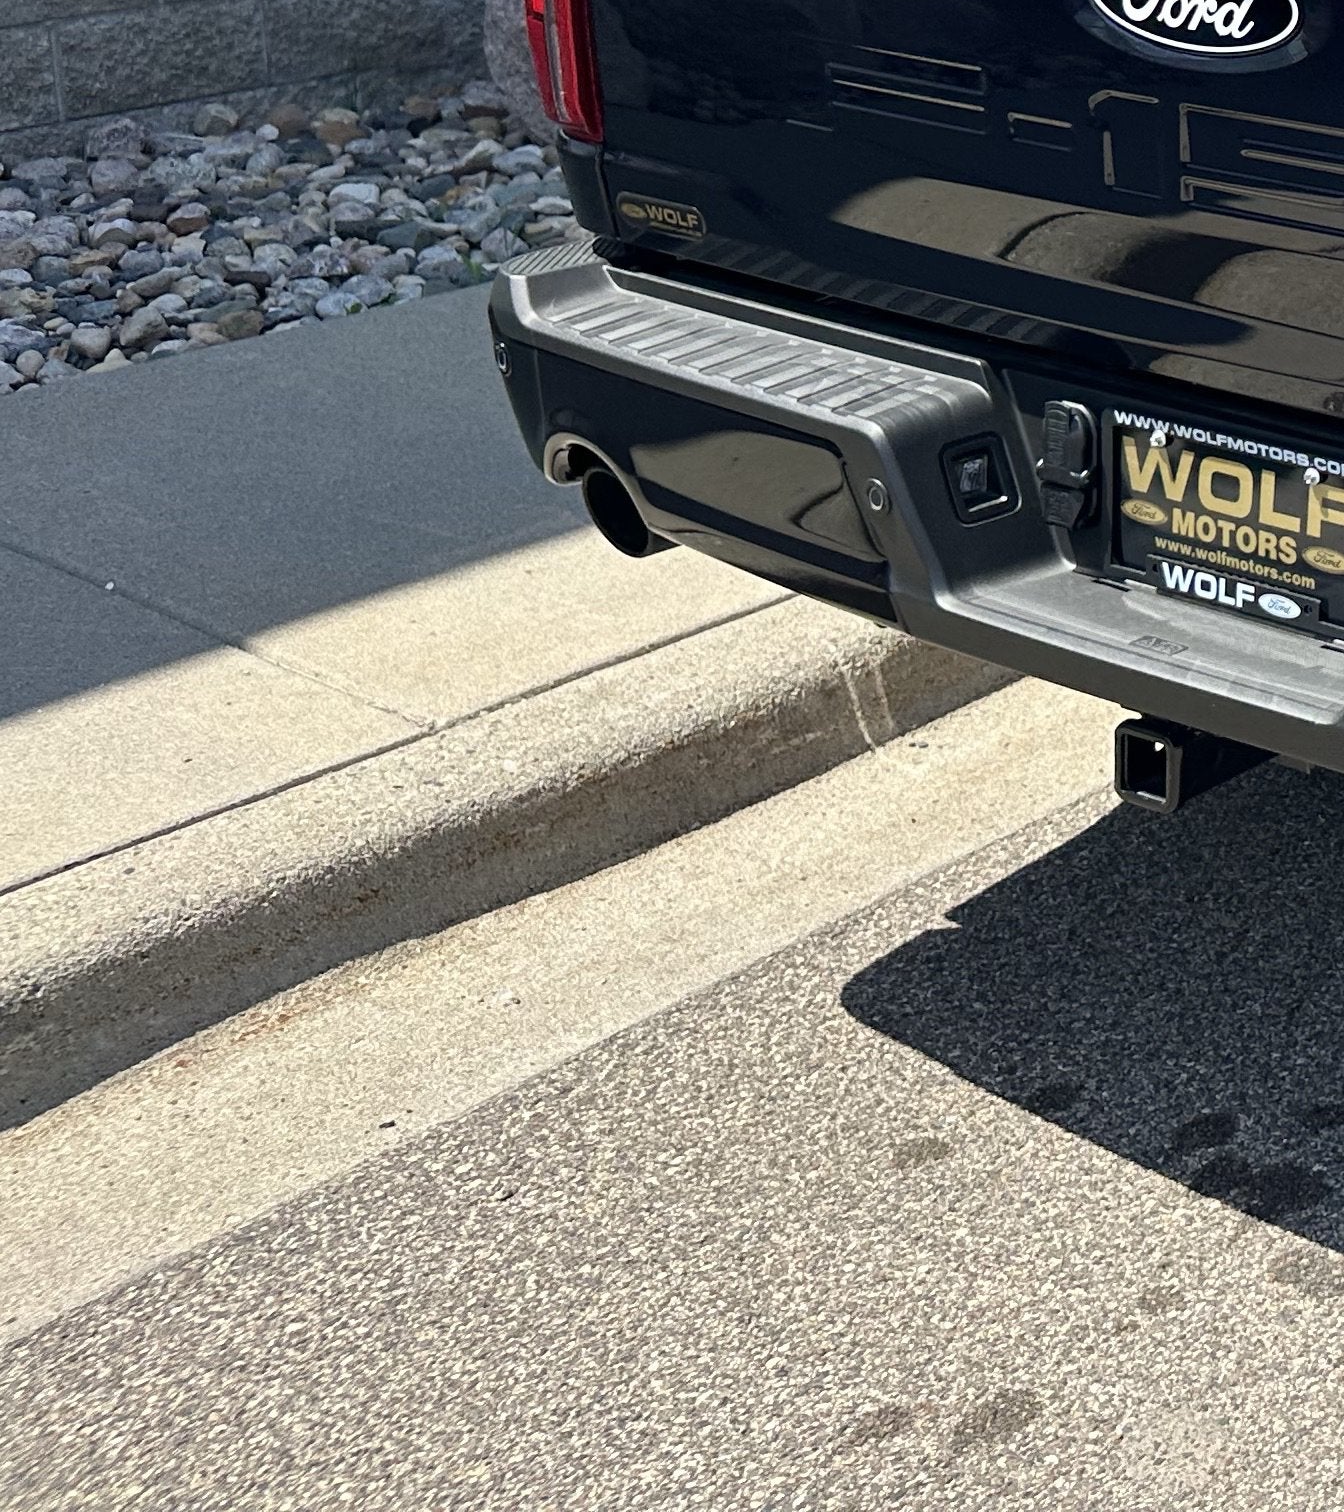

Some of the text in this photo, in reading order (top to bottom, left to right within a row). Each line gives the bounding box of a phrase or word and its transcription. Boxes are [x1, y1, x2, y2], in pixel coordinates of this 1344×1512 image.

[645, 203, 699, 228] WOLF
[1172, 507, 1298, 565] MOTORS
[1155, 536, 1316, 590] www.wolfmotors.com
[1161, 562, 1256, 608] WOLF
